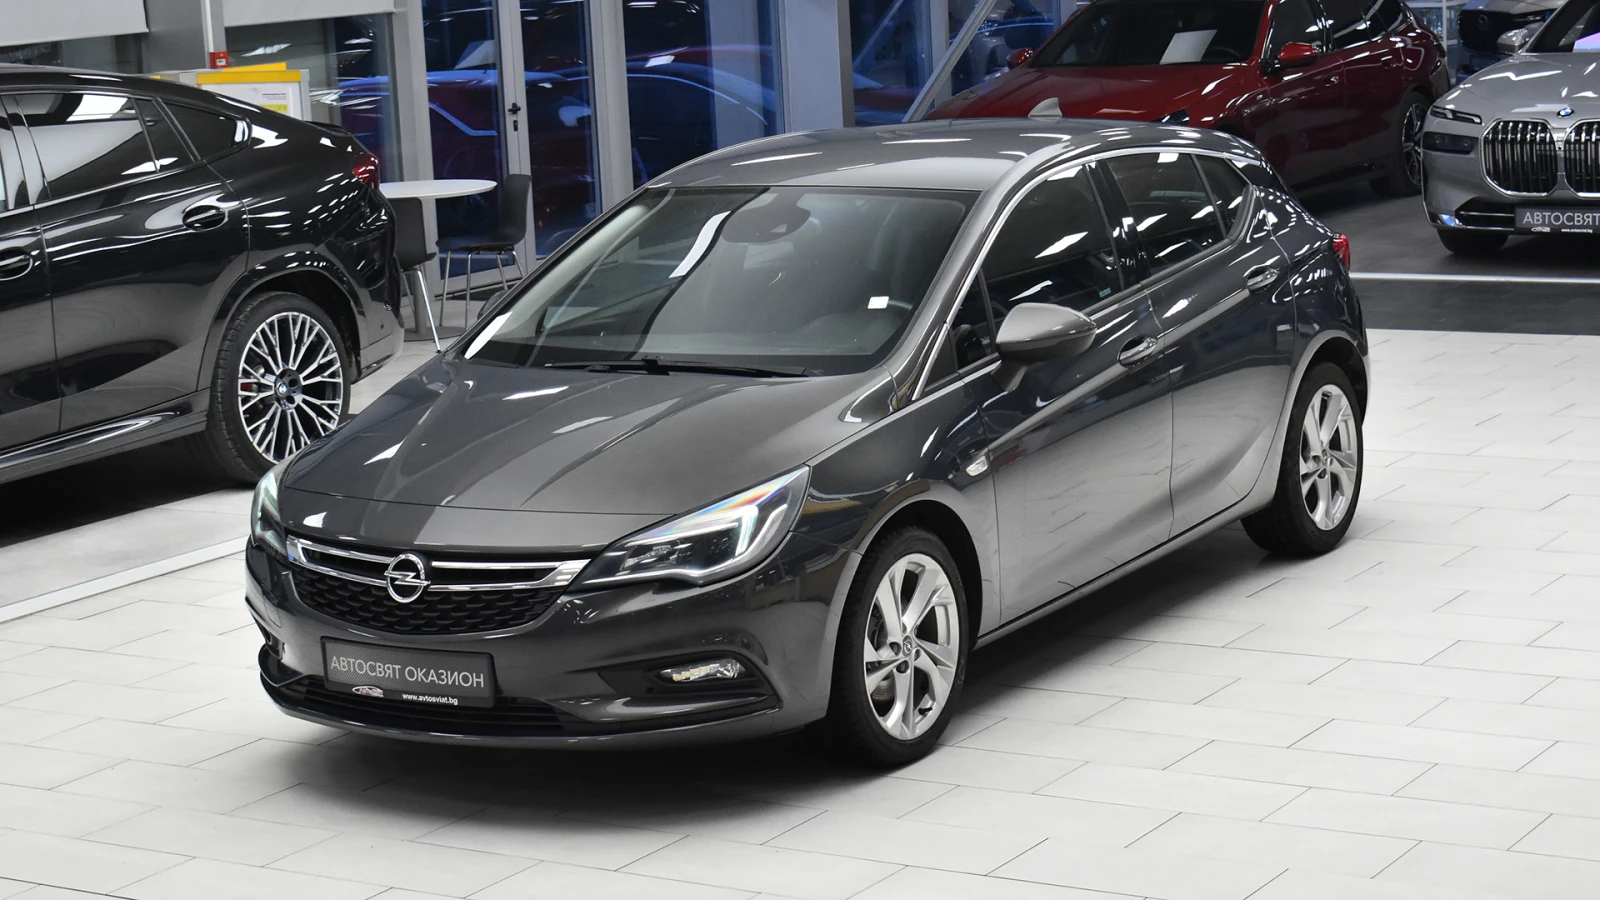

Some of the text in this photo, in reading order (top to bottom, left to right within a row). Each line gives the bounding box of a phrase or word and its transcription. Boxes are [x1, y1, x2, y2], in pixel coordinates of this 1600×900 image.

[1523, 212, 1600, 225] АВТОСВЯТ
[331, 656, 484, 688] АВТОСВЯТ ОКАЗИОН
[402, 693, 458, 705] www.avtosviat.bg
